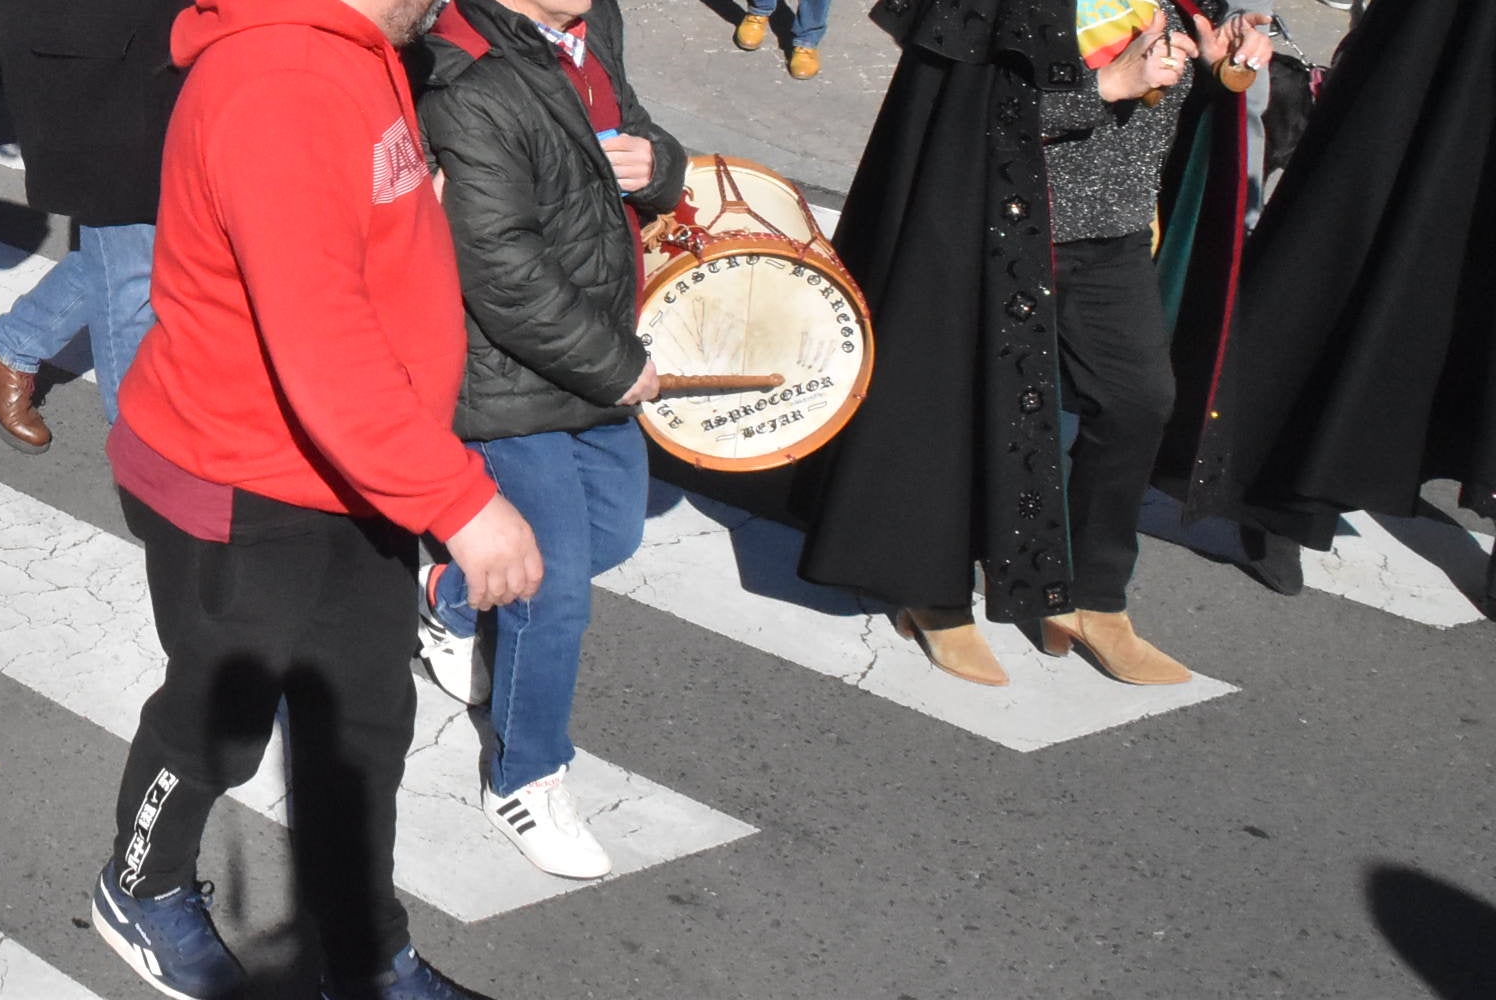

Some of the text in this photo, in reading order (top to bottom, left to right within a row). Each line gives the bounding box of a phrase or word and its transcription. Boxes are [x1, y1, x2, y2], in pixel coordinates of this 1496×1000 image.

[664, 255, 855, 353] CASTRO BORREGO
[742, 410, 804, 439] BEJAR
